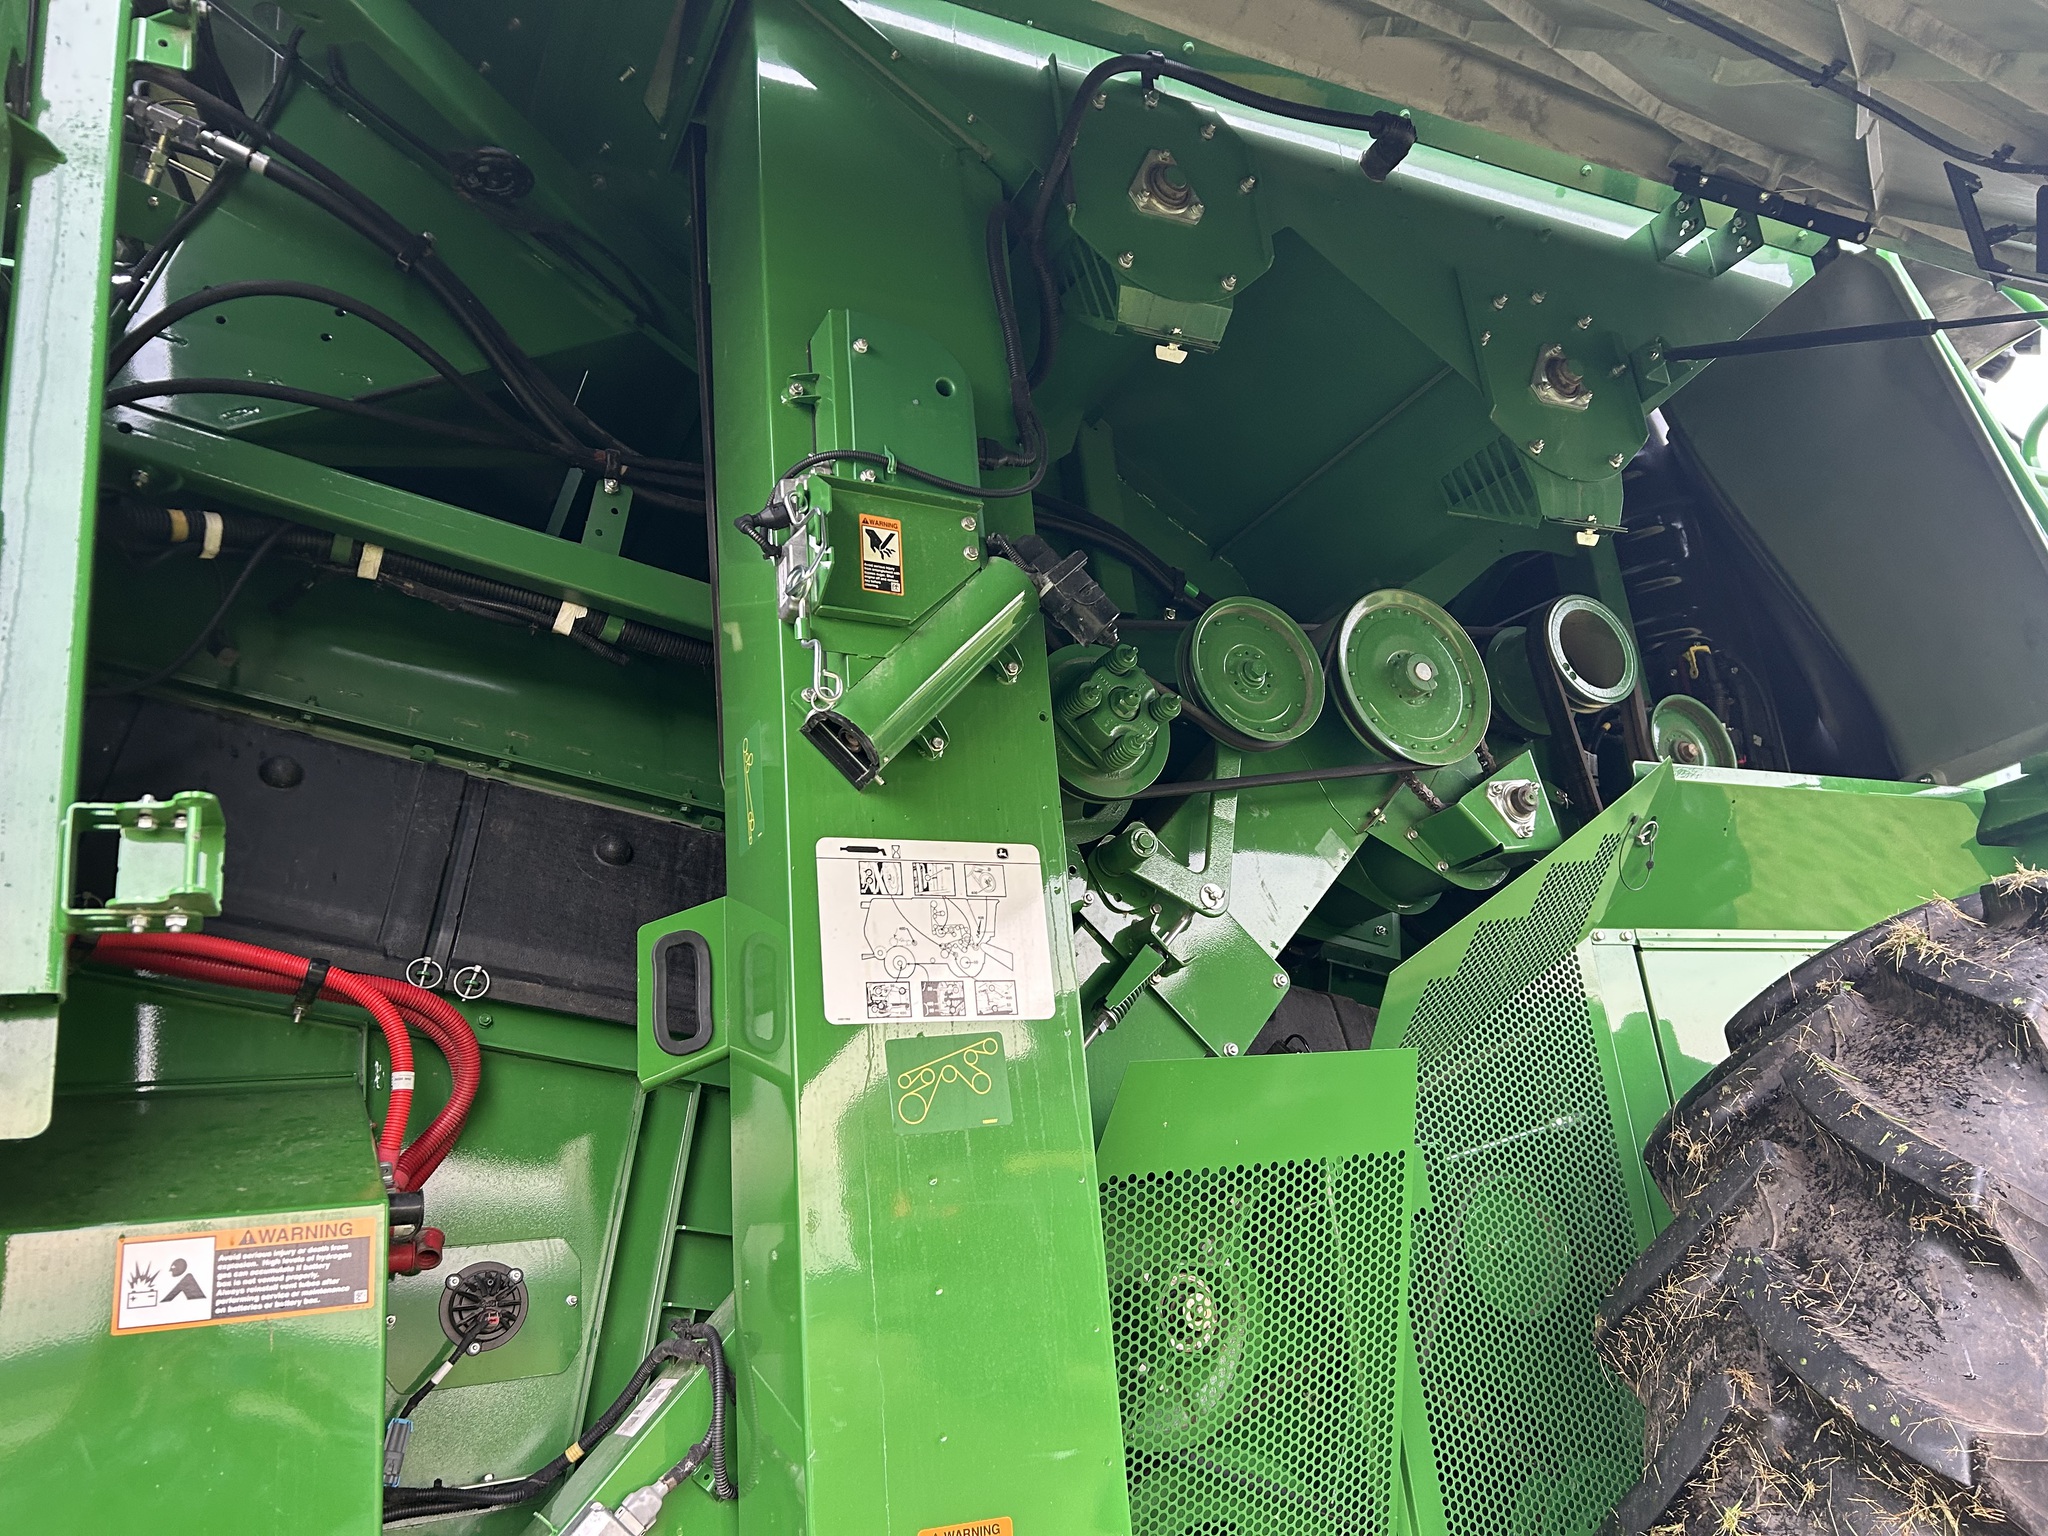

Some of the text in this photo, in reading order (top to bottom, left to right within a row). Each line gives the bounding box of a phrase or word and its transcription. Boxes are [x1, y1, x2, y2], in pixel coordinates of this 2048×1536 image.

[868, 519, 898, 529] WARNING
[259, 1223, 352, 1244] WARNING
[218, 1253, 241, 1262] Avoid
[243, 1251, 272, 1259] serious
[273, 1249, 296, 1257] injury
[307, 1245, 329, 1253] death
[262, 1258, 281, 1267] High
[282, 1256, 305, 1264] levels
[316, 1252, 352, 1262] hydrogen
[217, 1272, 232, 1280] gas
[250, 1266, 295, 1276] accumulate
[303, 1263, 330, 1271] battery
[216, 1278, 340, 1297] Always reinstall vent tubes after
[217, 1280, 231, 1288] box
[257, 1275, 284, 1284] vented
[216, 1295, 260, 1307] performing
[261, 1292, 290, 1300] service
[301, 1286, 350, 1296] maintenance
[227, 1304, 263, 1312] batteries
